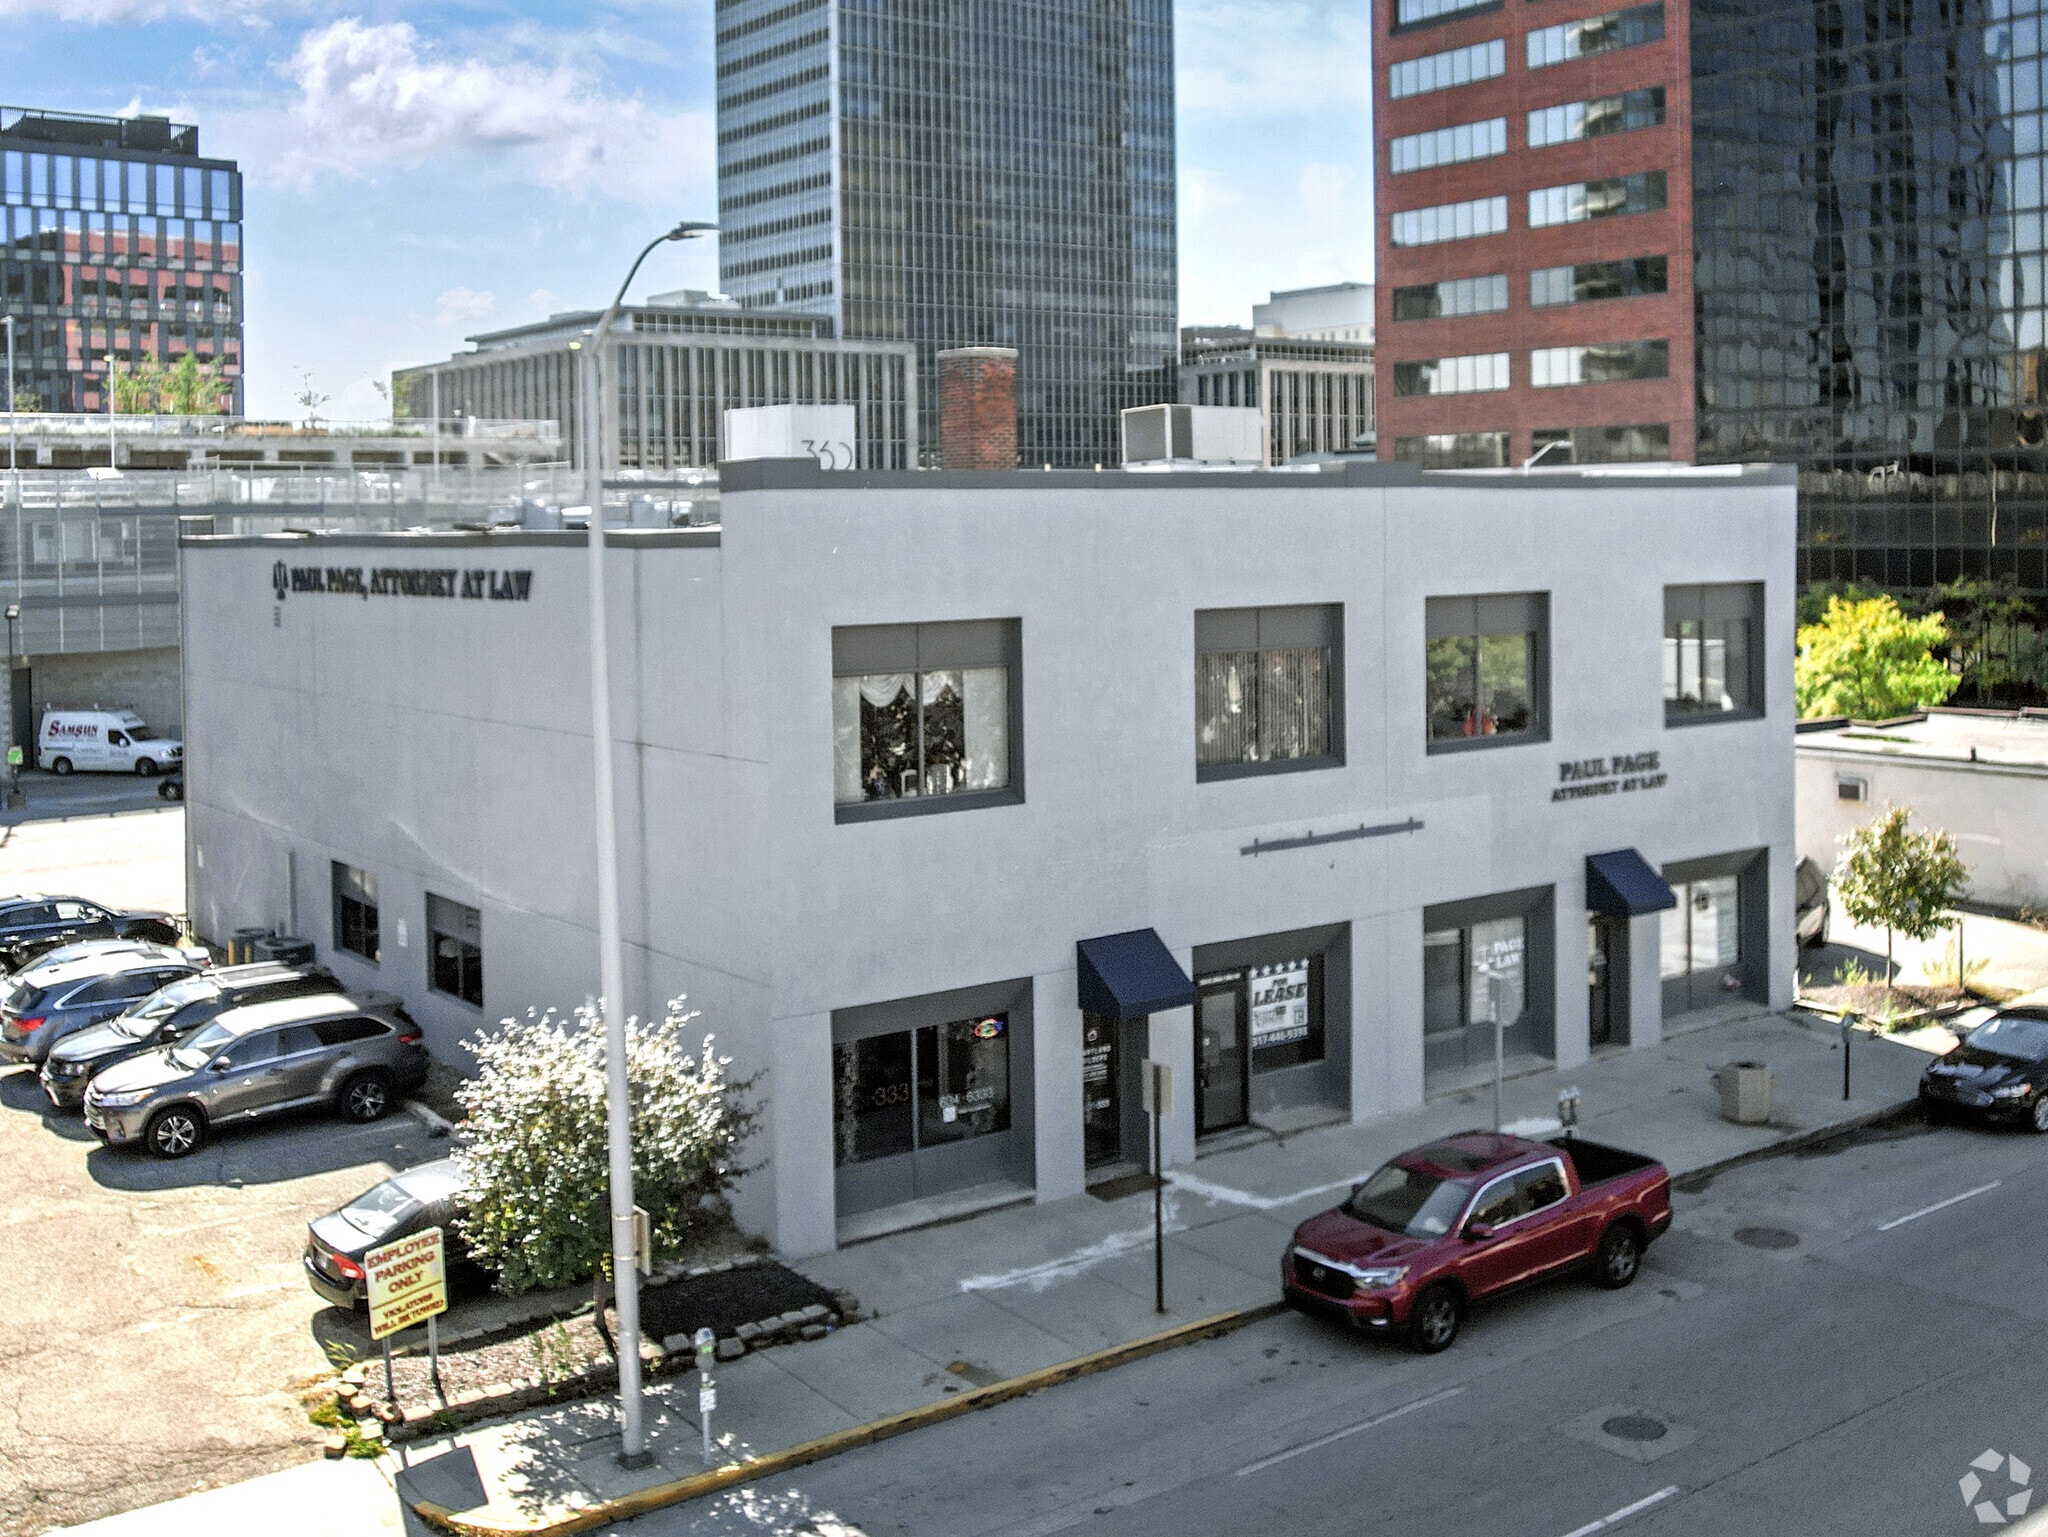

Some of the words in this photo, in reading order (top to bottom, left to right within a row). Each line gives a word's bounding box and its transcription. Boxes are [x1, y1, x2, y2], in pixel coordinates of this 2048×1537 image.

[291, 566, 325, 593] PAUL
[369, 569, 457, 598] ATTORNEY
[461, 569, 486, 600] AT
[487, 570, 532, 601] LAW
[1559, 757, 1609, 782] PAUL
[1611, 750, 1660, 776] PAGE
[1551, 780, 1620, 802] ATTORNEY
[1621, 777, 1641, 793] AT
[1640, 773, 1668, 790] LAW
[1254, 983, 1307, 1006] LEASE
[367, 1233, 440, 1269] EMPLOYEE
[375, 1251, 435, 1283] PARKING
[388, 1270, 424, 1294] ONLY
